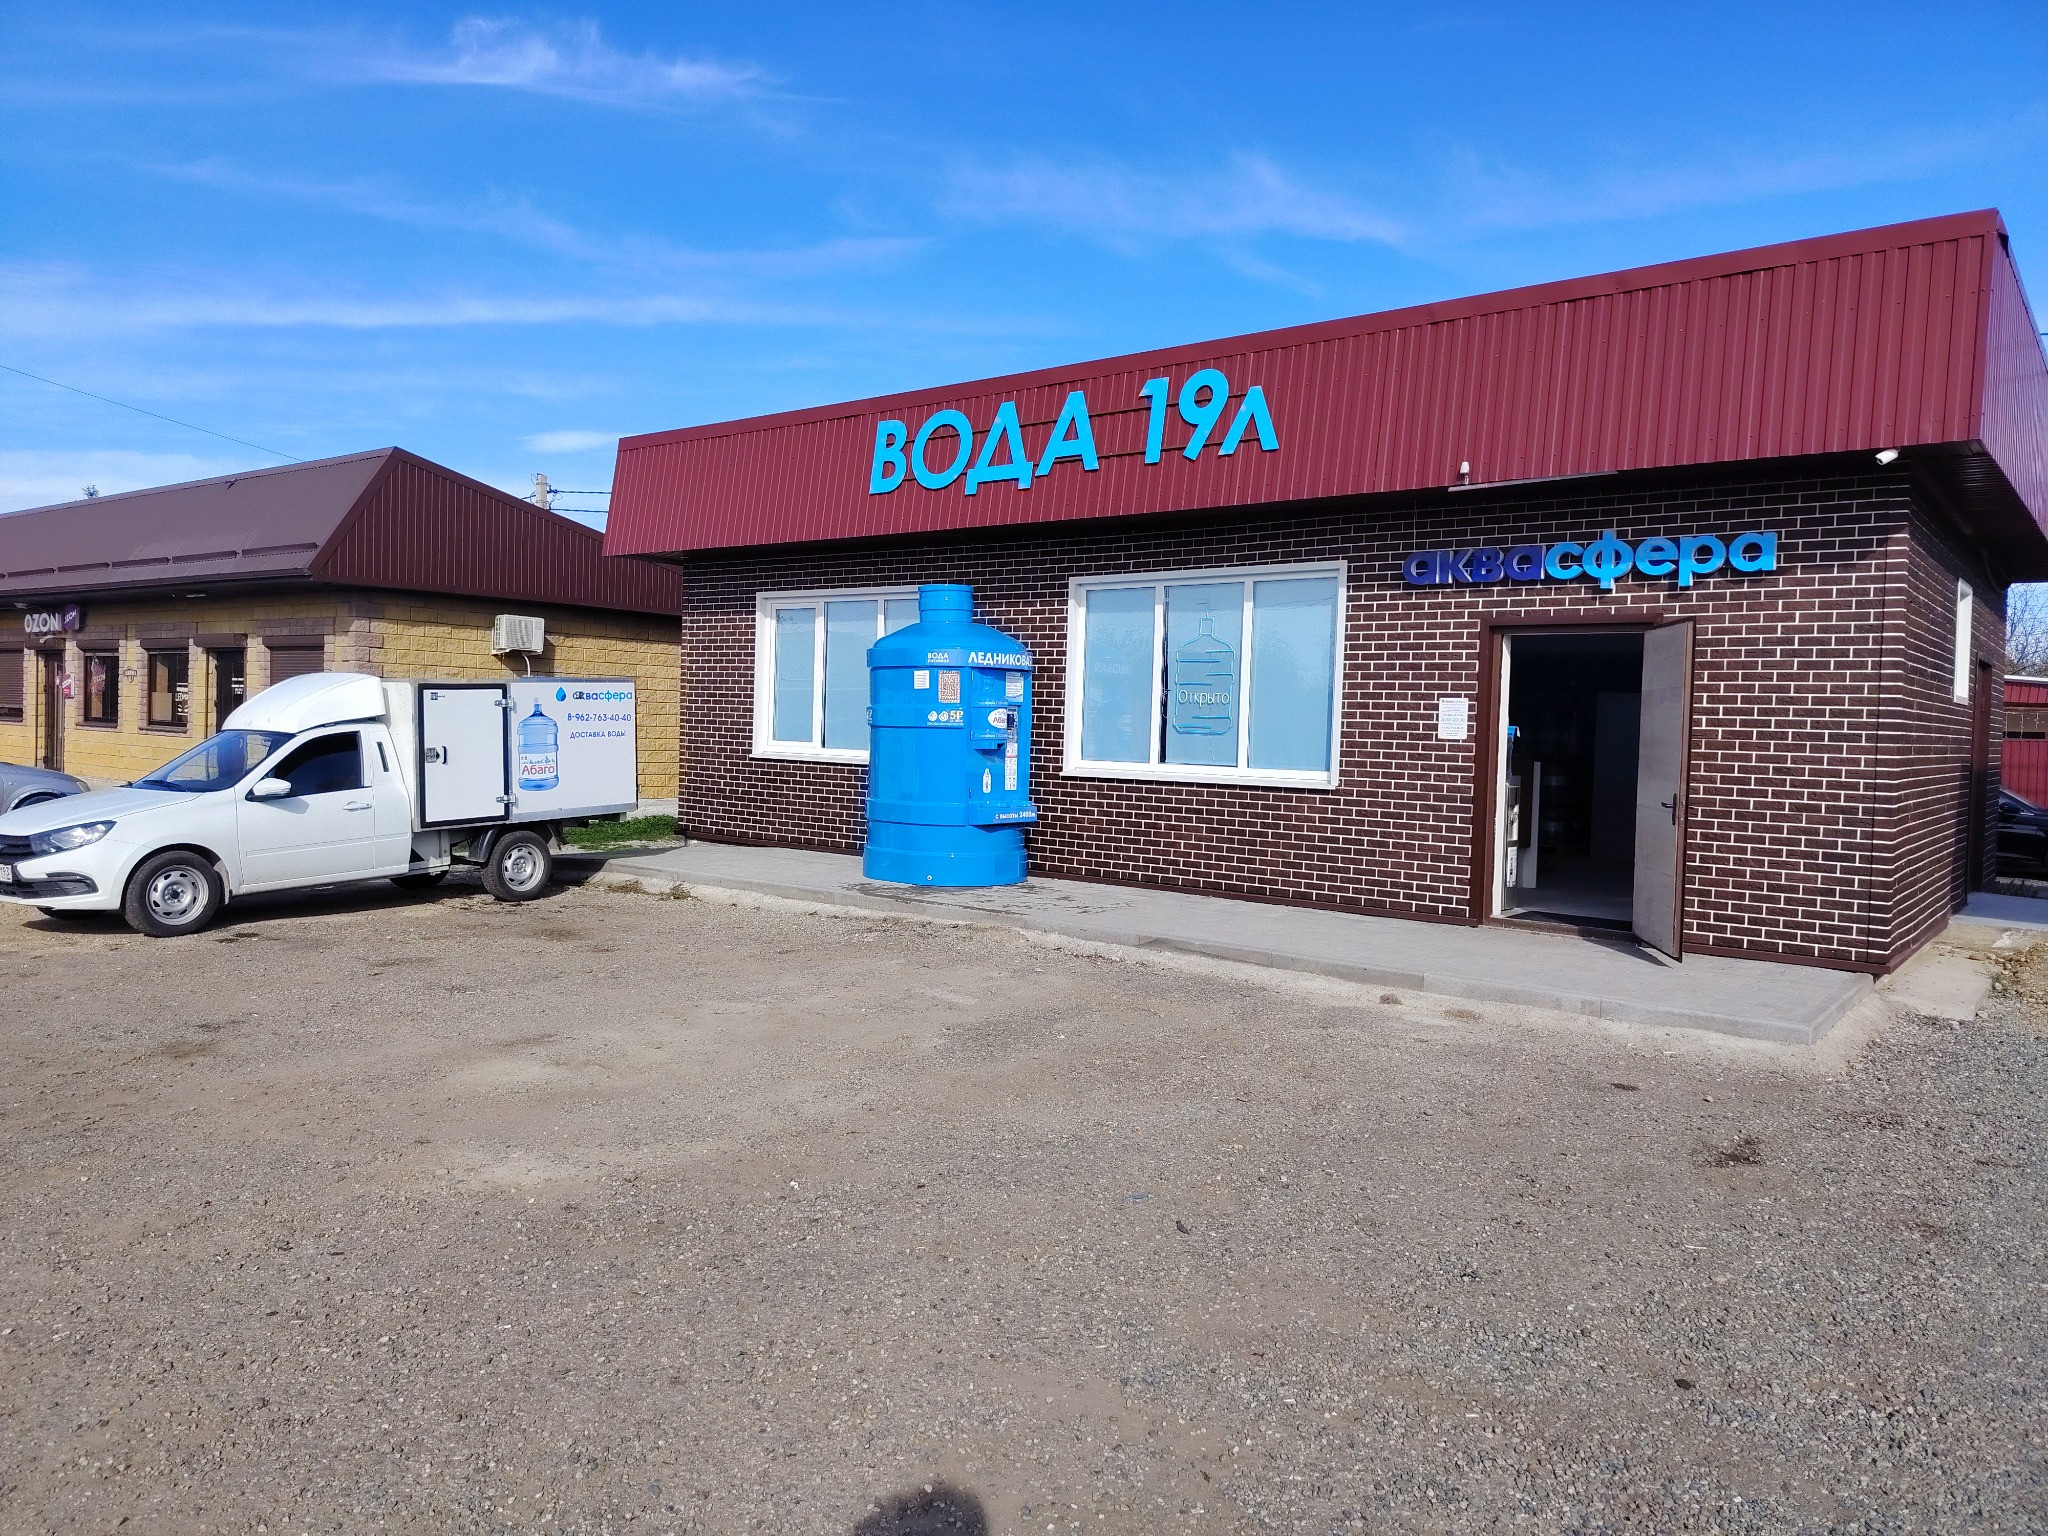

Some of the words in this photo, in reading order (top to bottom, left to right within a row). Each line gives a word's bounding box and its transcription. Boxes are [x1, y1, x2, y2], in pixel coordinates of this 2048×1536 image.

[869, 390, 1099, 495] ВОДА
[1138, 368, 1279, 464] 19л
[1402, 529, 1778, 589] аквасфера
[24, 612, 60, 633] OZON
[927, 652, 949, 660] ВОДА
[1178, 689, 1230, 708] Открыто
[567, 712, 631, 722] 8-962-763-40-40
[570, 731, 606, 740] ДОСТАВКА
[607, 730, 626, 738] ВОДЫ
[521, 764, 555, 776] Абаго
